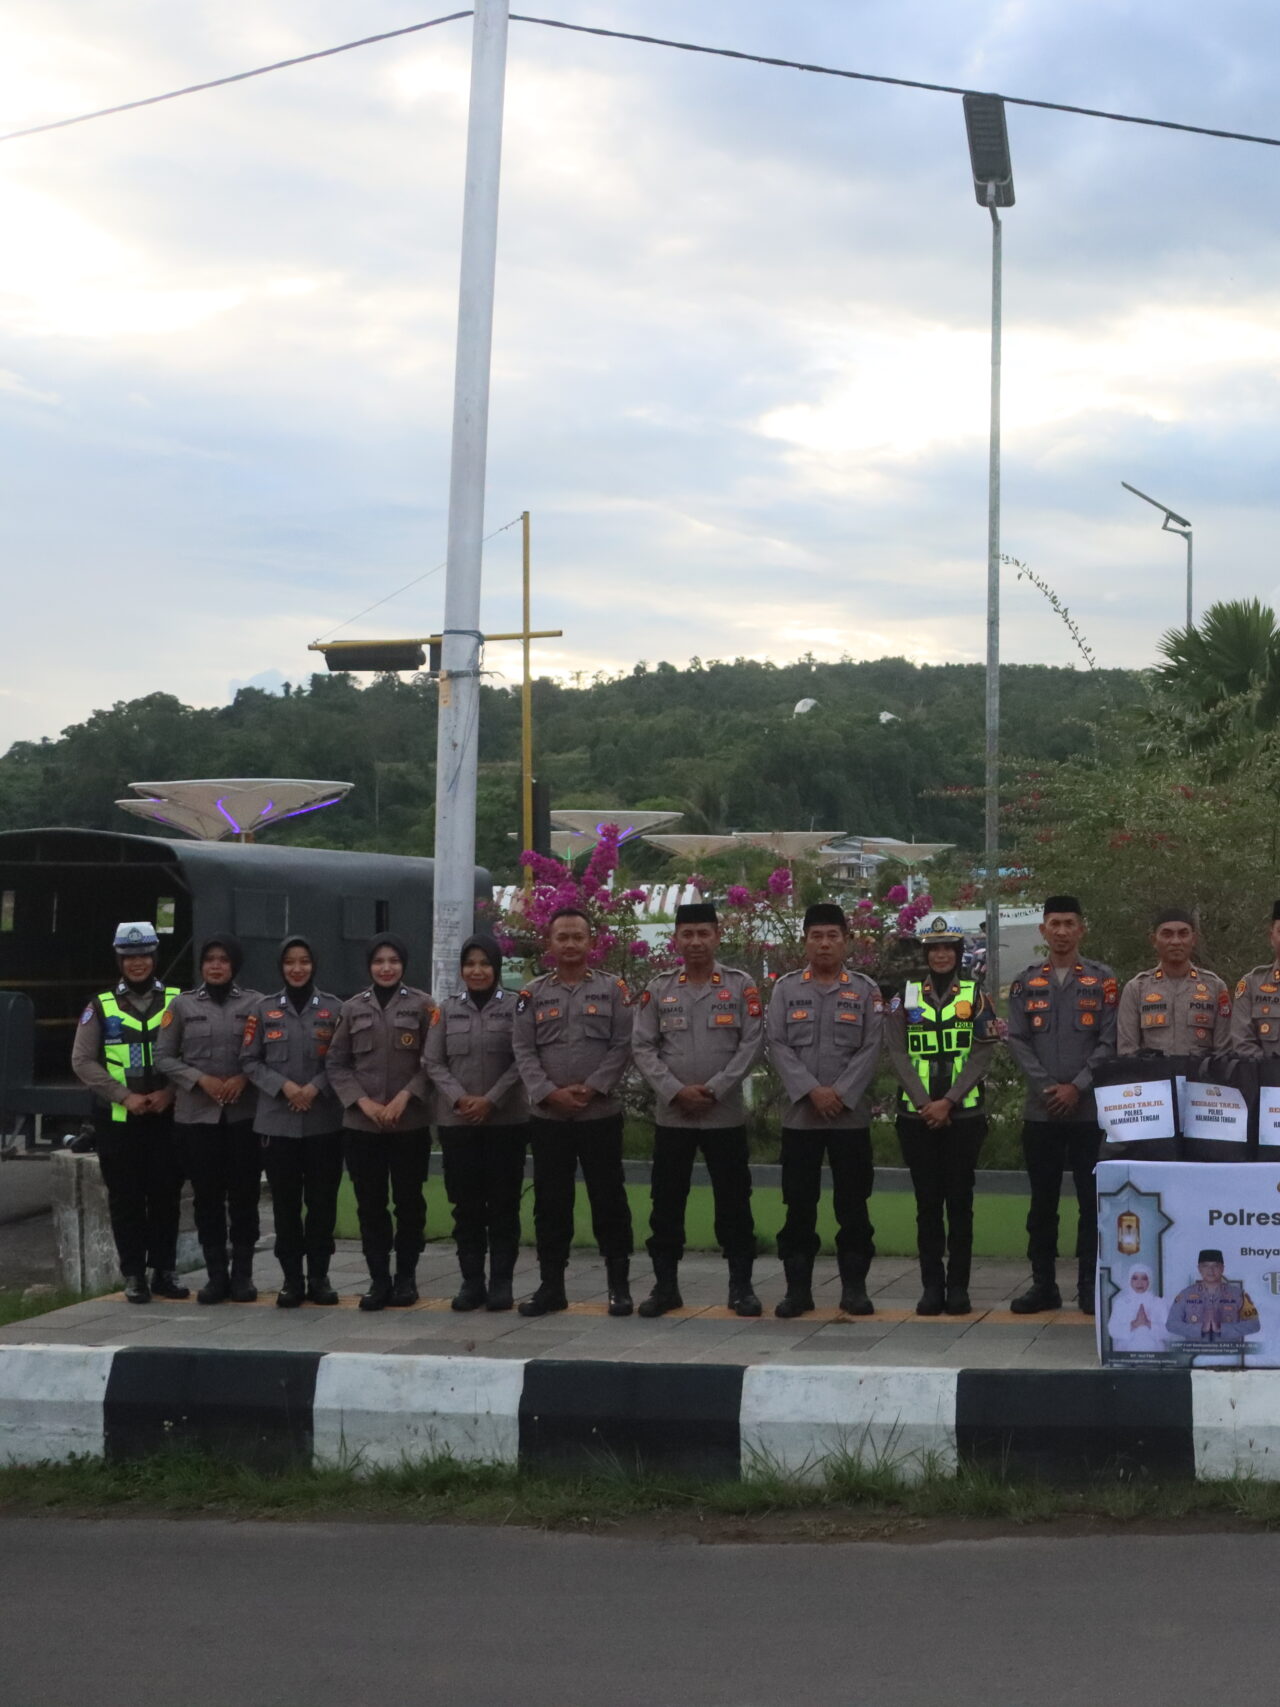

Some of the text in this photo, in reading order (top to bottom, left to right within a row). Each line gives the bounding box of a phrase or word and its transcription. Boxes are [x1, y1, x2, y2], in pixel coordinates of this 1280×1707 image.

[711, 1003, 737, 1011] POLRI
[1110, 1114, 1160, 1126] HALMAHERA TENGAH
